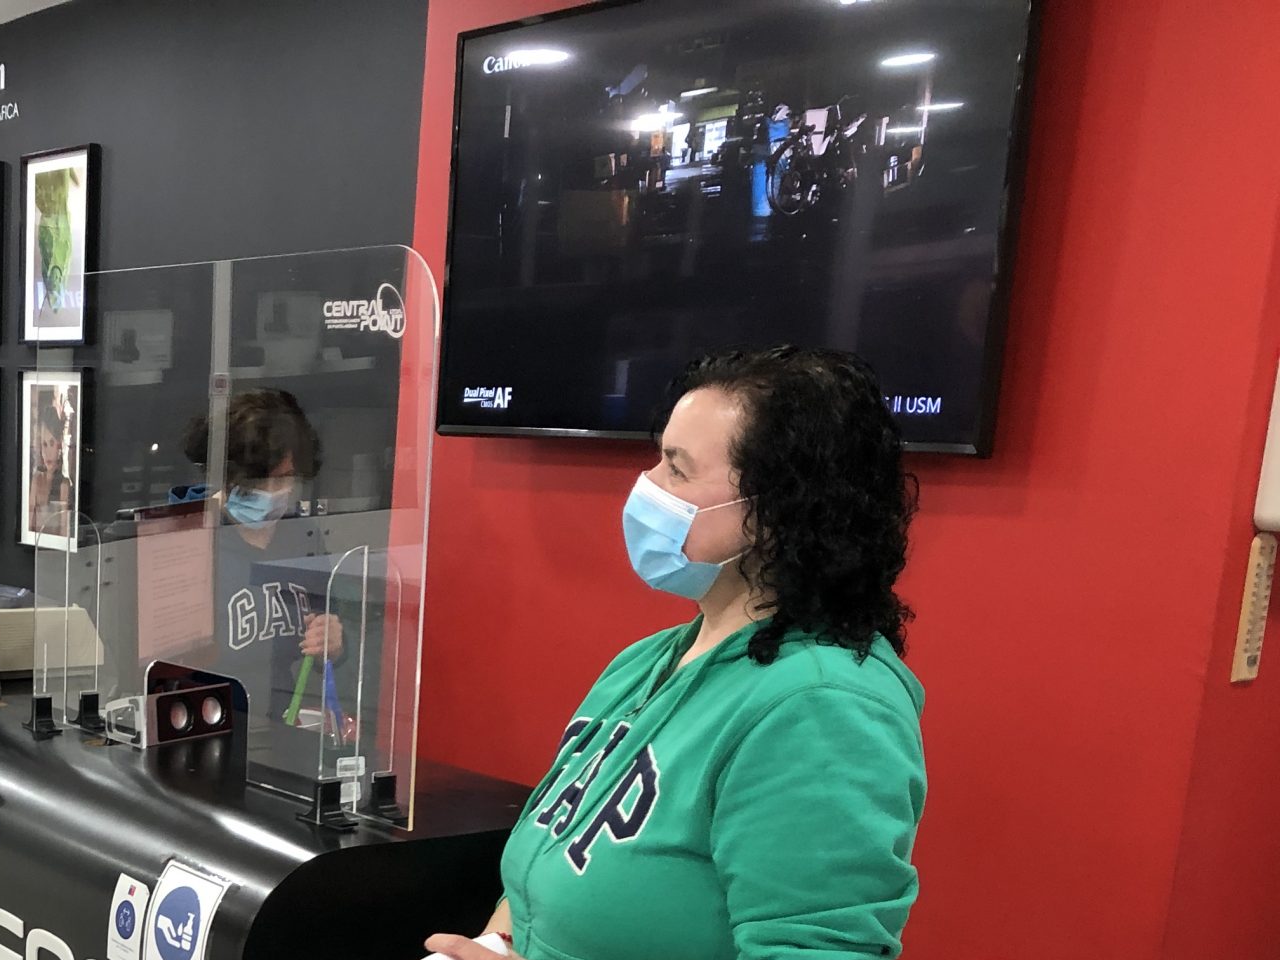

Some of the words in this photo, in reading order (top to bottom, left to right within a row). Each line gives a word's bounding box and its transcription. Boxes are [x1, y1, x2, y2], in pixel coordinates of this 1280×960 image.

[323, 299, 388, 318] CENTRAL
[464, 386, 480, 398] Dual
[479, 386, 496, 398] Pixel
[493, 386, 513, 409] AF
[906, 396, 942, 414] USM
